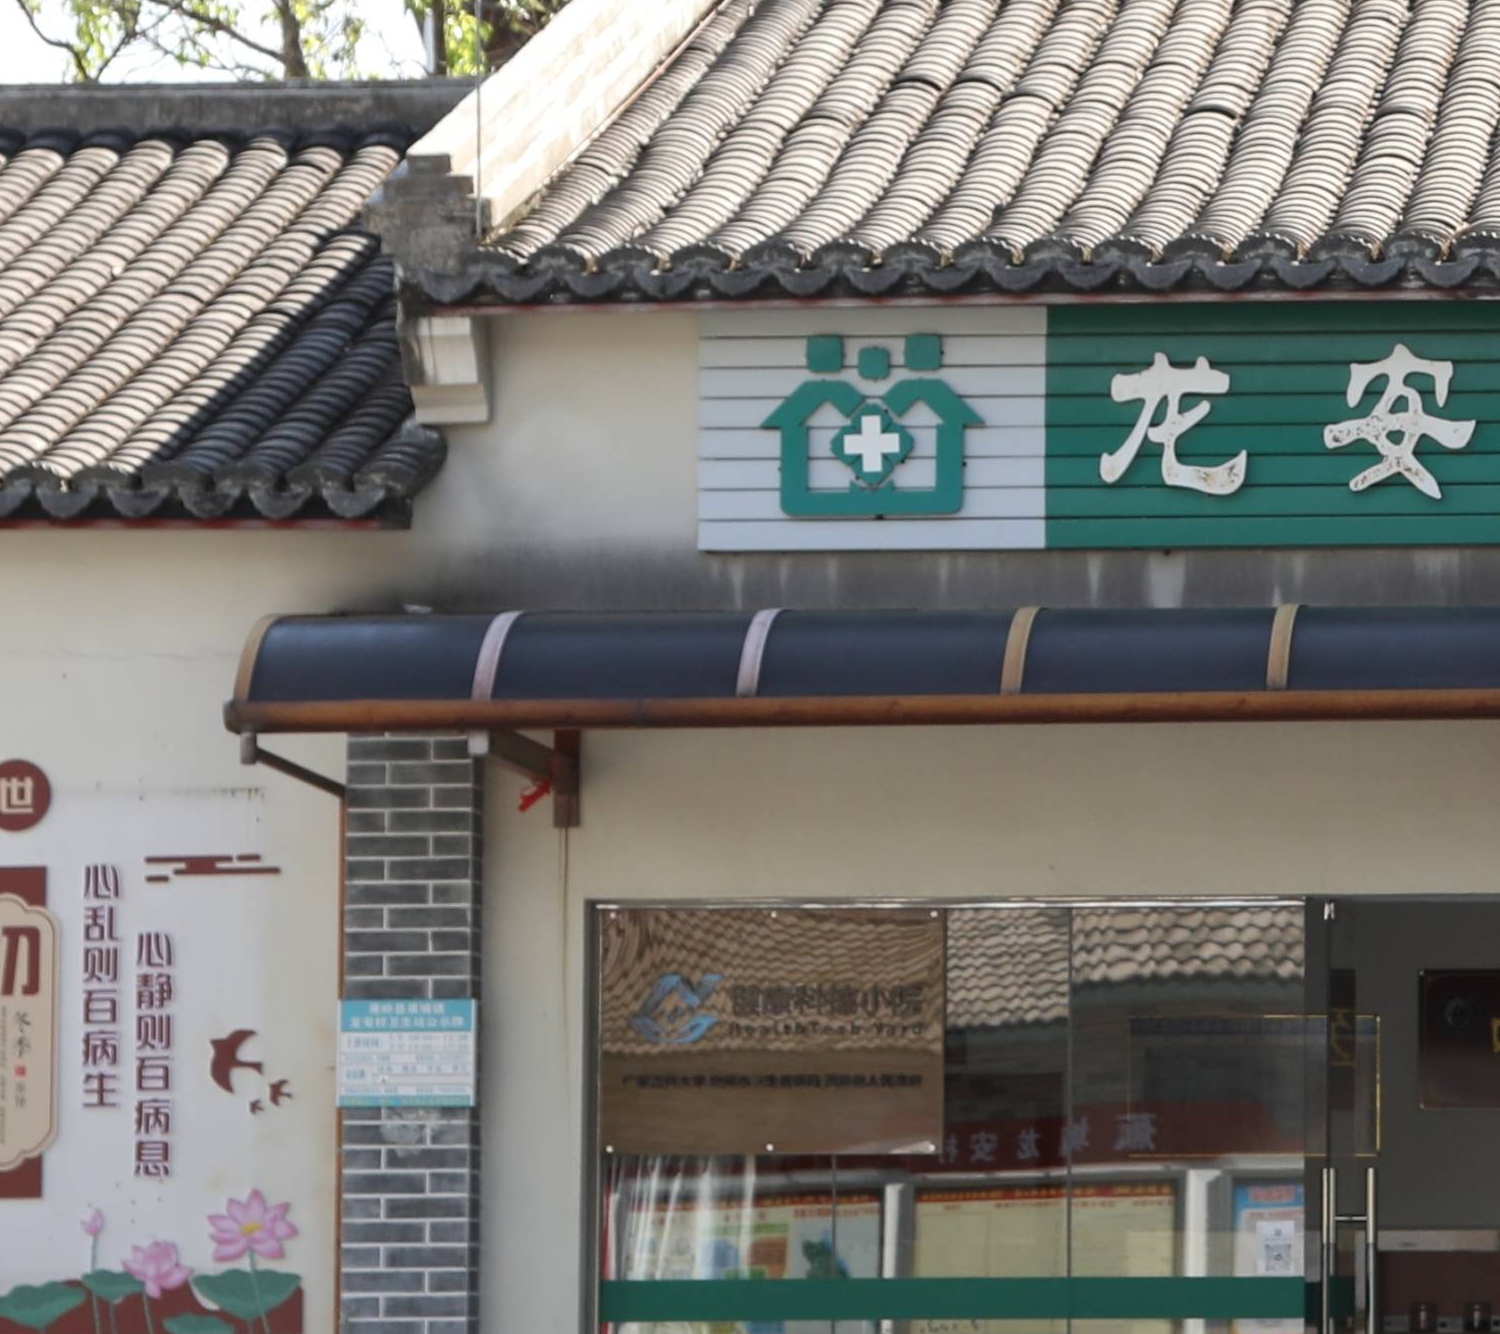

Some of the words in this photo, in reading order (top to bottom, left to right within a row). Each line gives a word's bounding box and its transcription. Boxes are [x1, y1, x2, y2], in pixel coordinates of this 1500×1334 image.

[82, 864, 120, 1108] 心乱则百病生
[134, 931, 173, 1178] 心静则百病息
